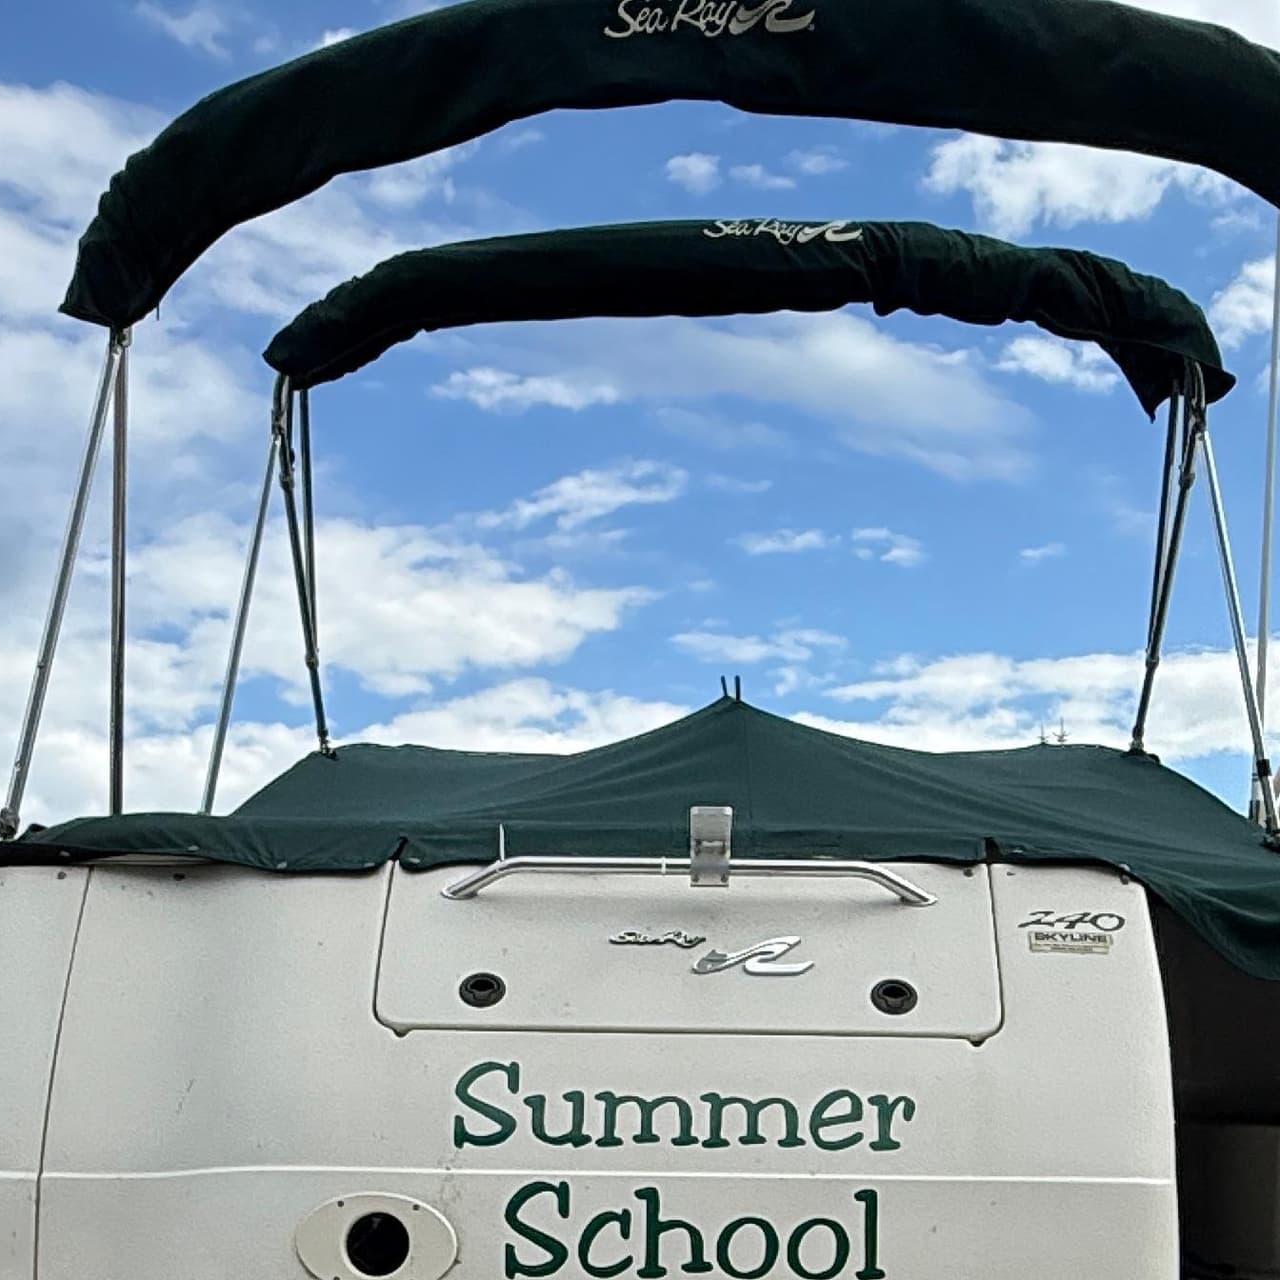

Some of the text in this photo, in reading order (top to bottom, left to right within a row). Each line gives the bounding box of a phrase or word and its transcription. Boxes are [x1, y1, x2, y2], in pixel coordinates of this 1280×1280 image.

[604, 0, 737, 38] Sea Ray
[703, 218, 802, 245] Sea Ray
[1017, 910, 1126, 932] 240
[1034, 931, 1108, 943] SKYLINE
[453, 1060, 916, 1151] Summer
